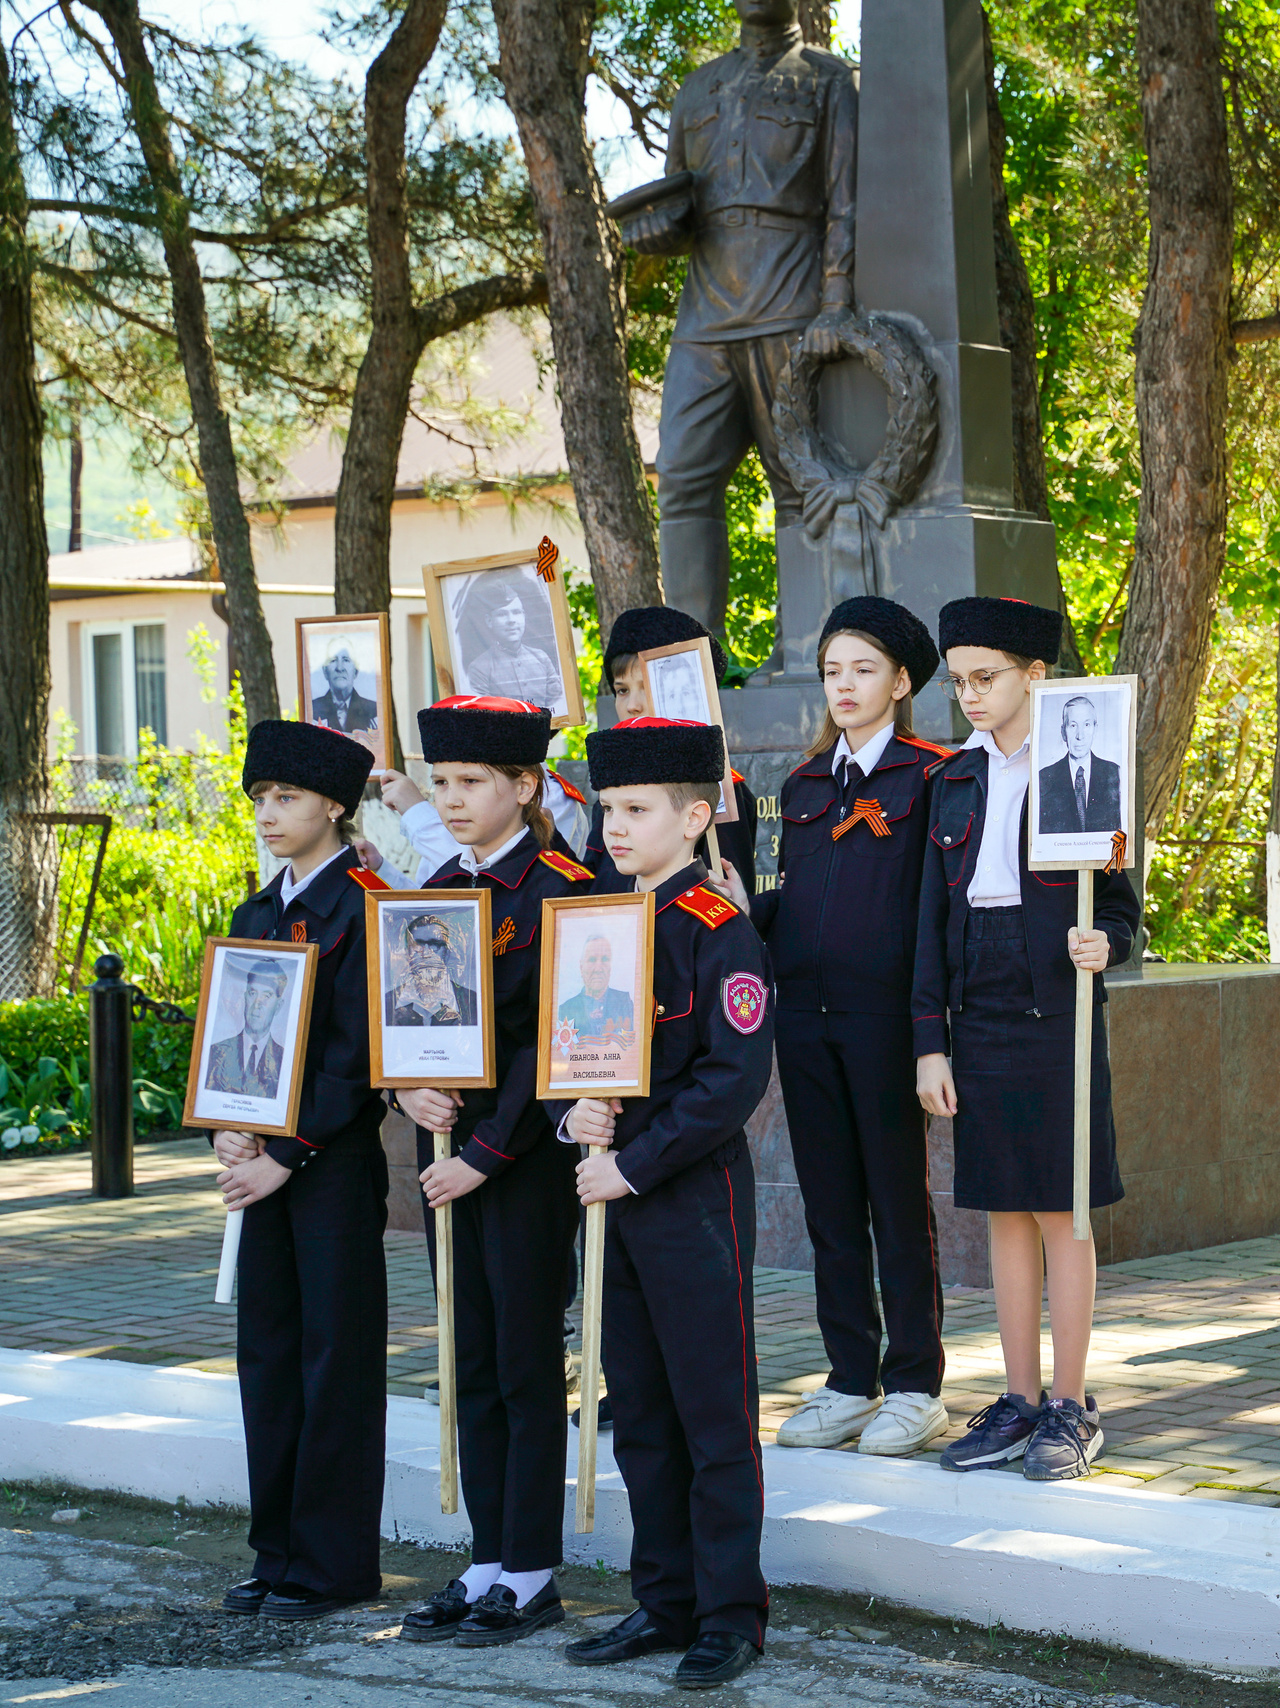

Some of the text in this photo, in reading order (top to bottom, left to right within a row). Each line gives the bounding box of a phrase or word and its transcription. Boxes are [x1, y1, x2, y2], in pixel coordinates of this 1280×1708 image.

[706, 903, 728, 919] КК
[569, 1053, 600, 1062] ИВАНОВА
[573, 1071, 616, 1079] ВАСИЛЬЕВНА
